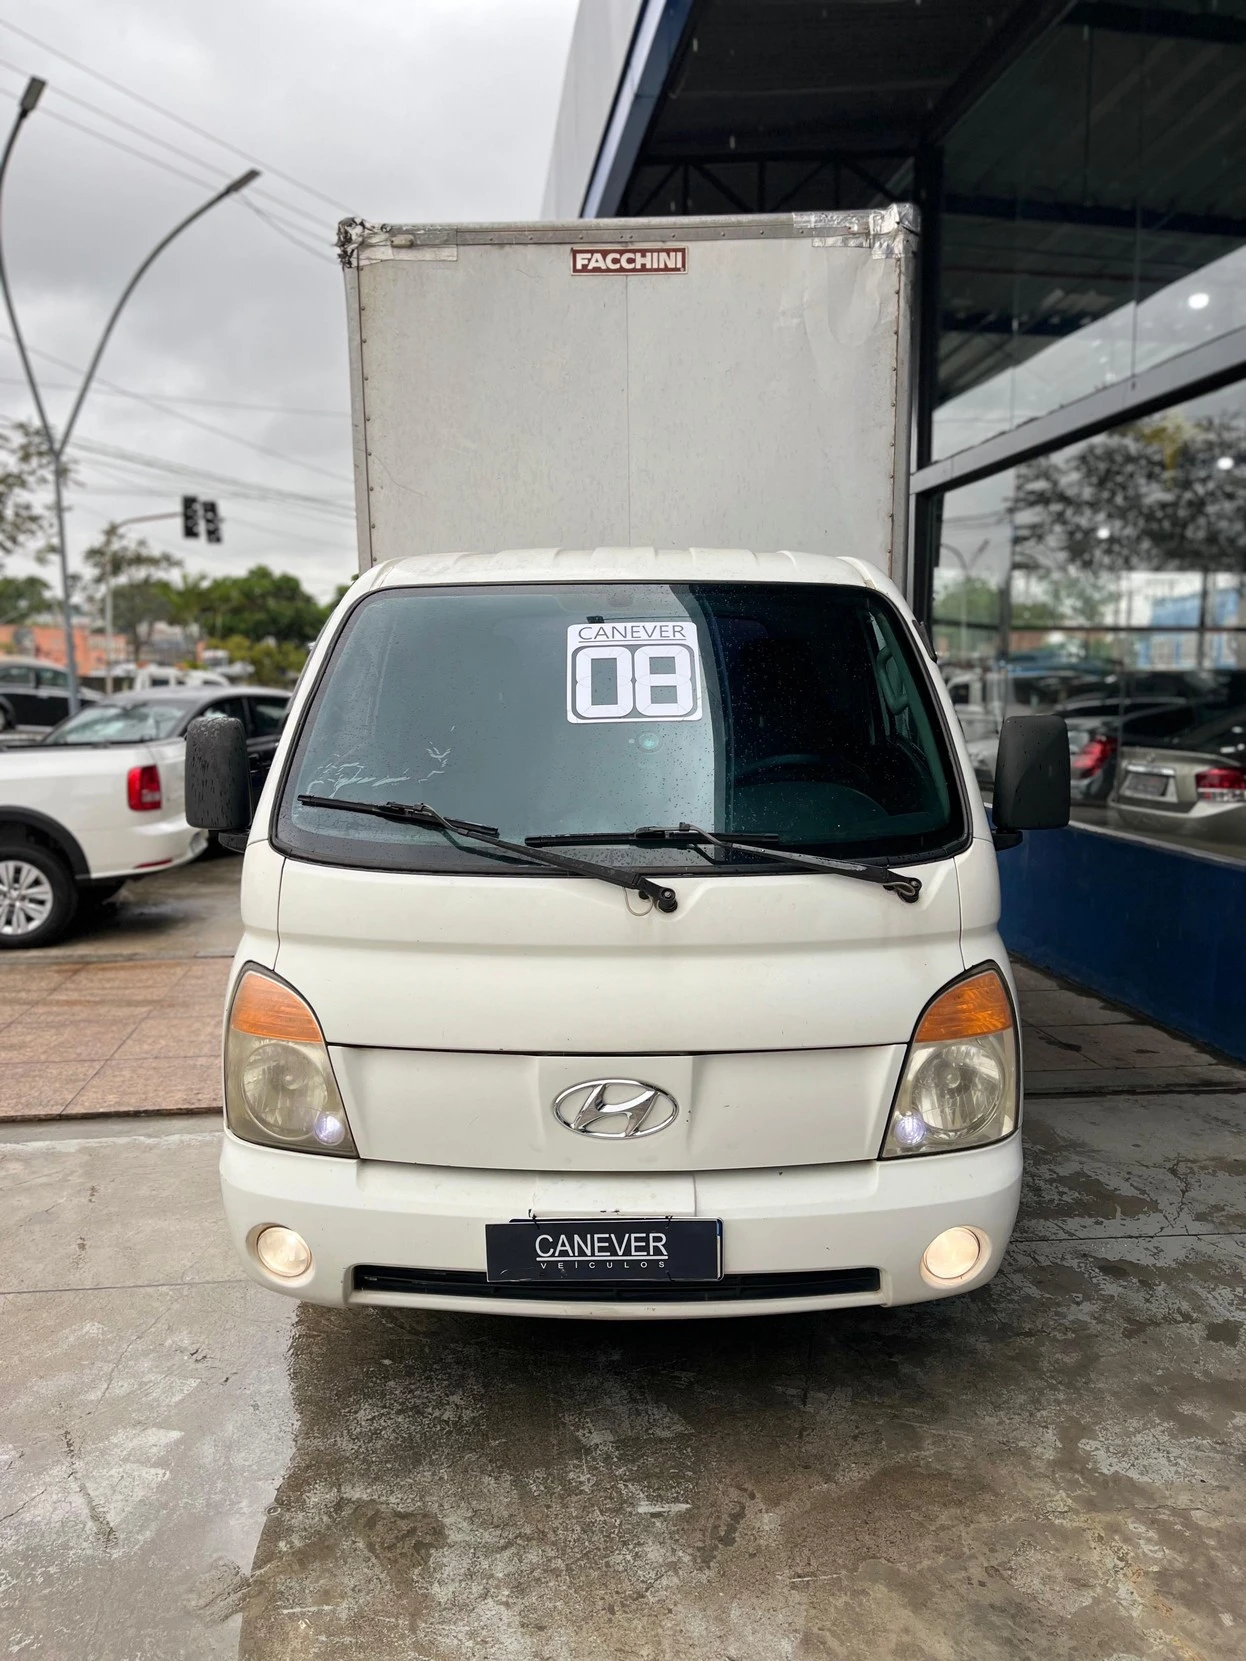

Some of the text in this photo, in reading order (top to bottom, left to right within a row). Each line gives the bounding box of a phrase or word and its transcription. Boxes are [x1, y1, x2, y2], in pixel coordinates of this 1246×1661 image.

[575, 252, 682, 270] FACCHINI
[578, 624, 686, 640] CANEVER
[575, 645, 694, 718] 08
[535, 1233, 668, 1257] CANEVER
